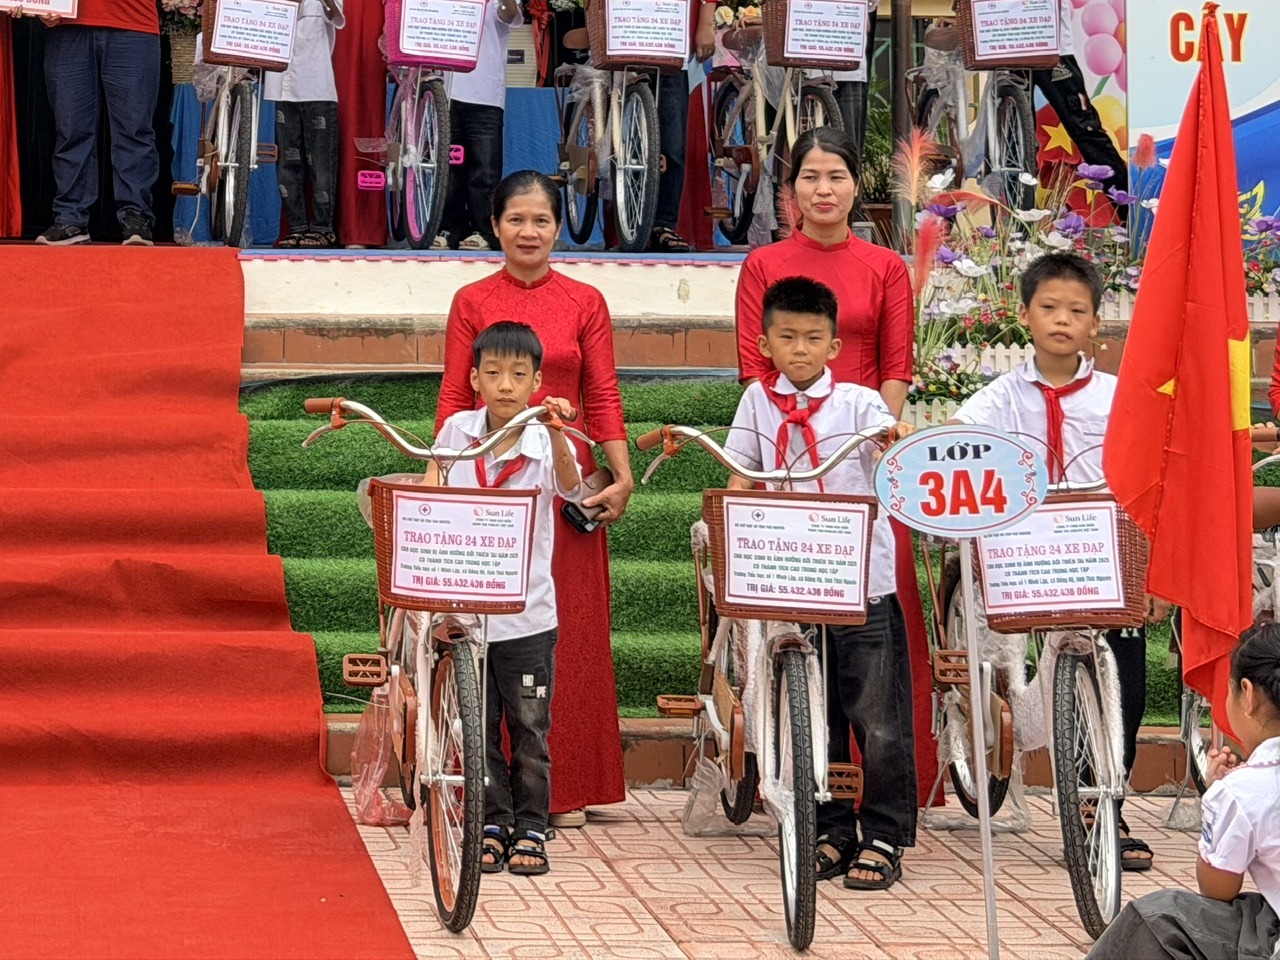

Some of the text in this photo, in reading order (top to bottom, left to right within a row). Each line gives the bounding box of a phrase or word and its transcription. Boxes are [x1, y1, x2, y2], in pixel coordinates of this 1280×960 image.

[1170, 12, 1248, 62] CY
[927, 441, 992, 462] LỚP
[919, 469, 1007, 517] 3A4
[404, 531, 431, 544] TRAO
[434, 532, 462, 547] TẶNG
[465, 536, 477, 546] 24
[480, 537, 495, 547] XE
[737, 537, 765, 550] TRAO
[768, 538, 798, 554] TẶNG
[801, 543, 813, 553] 24
[817, 544, 831, 554] XE
[987, 547, 1013, 559] TRAO
[1016, 544, 1046, 559] TẶNG
[1049, 544, 1061, 554] 24
[1065, 544, 1080, 553] XE
